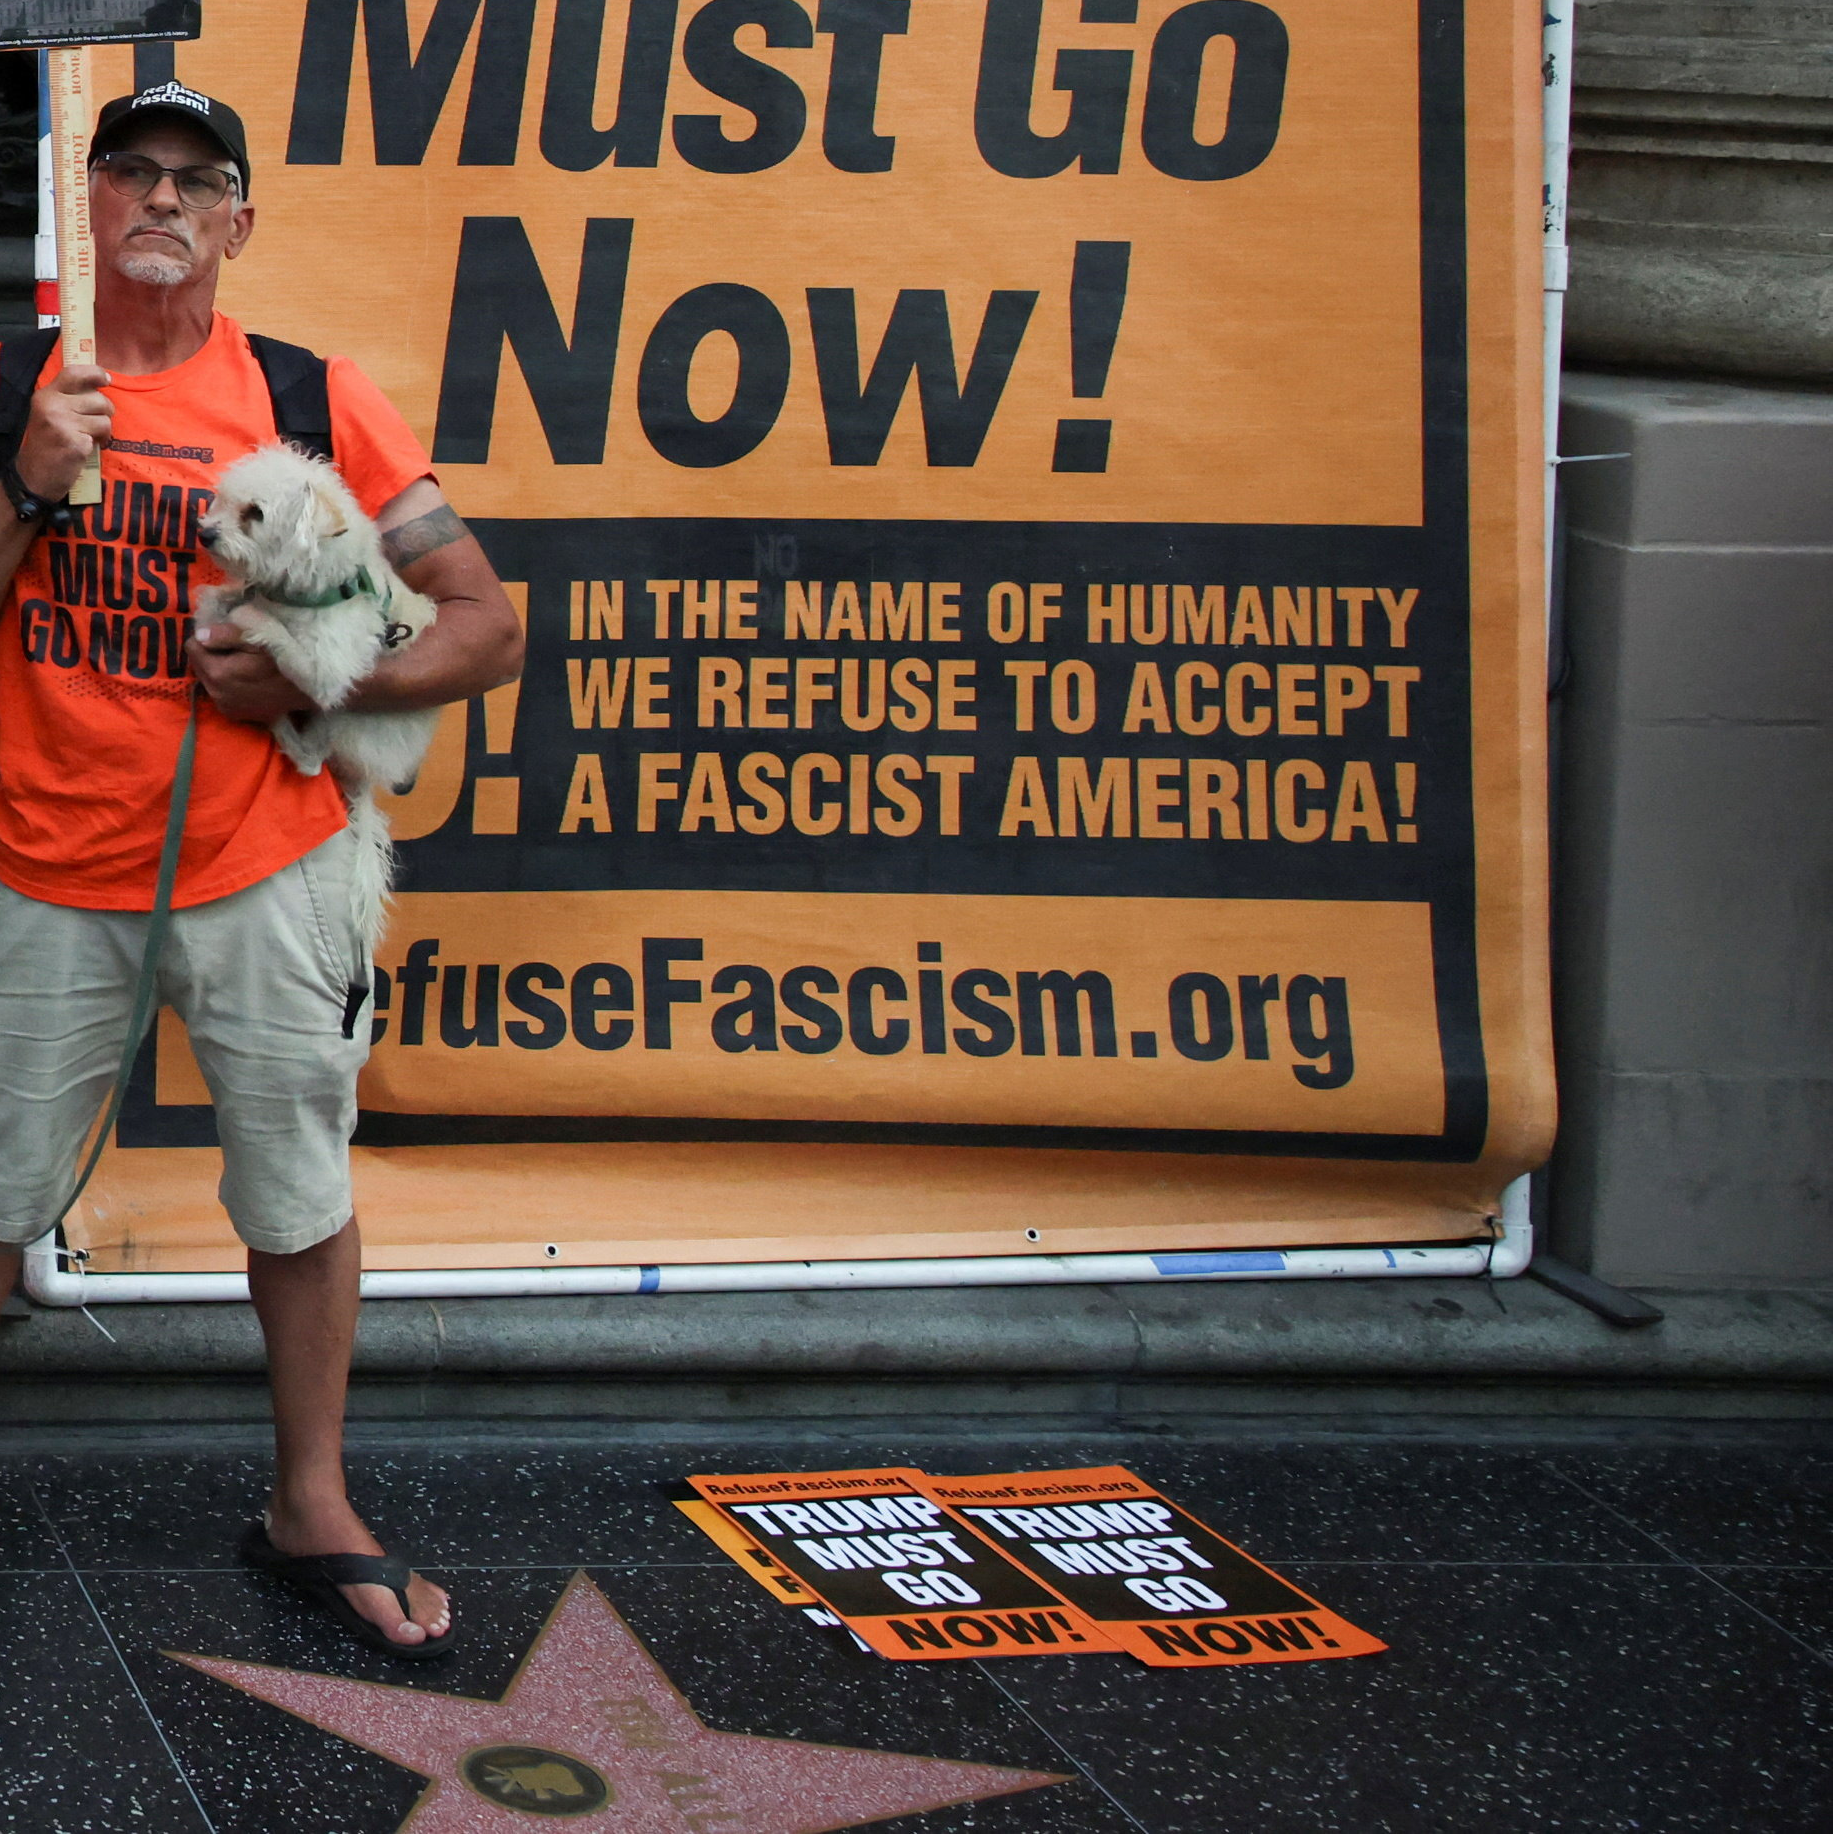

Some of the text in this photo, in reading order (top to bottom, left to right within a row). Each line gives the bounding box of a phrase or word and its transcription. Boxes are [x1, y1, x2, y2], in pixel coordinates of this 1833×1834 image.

[132, 92, 210, 115] Fascism!
[143, 82, 205, 101] Refuse
[73, 131, 85, 188] DEPOT
[75, 190, 89, 241] HOME
[431, 217, 1131, 473] Now!
[110, 439, 213, 463] ascism.org
[49, 541, 196, 613] MUST
[20, 599, 80, 668] GO
[570, 580, 1418, 648] IN THE NAME OF HUMANITY
[567, 657, 1420, 736] WE REFUSE TO ACCEPT
[559, 752, 1416, 842] A FASCIST AMERICA!
[370, 934, 1357, 1092] fuseFascism.org
[933, 1481, 1139, 1498] RefuseFascism.org
[731, 1496, 942, 1536] TRUMP
[962, 1501, 1173, 1538] TRUMP
[793, 1531, 974, 1571] MUST
[1031, 1536, 1214, 1576] MUST
[882, 1570, 981, 1607] GO
[1124, 1576, 1228, 1614] GO
[886, 1612, 1084, 1652] NOW!
[1143, 1616, 1342, 1657] NOW!
